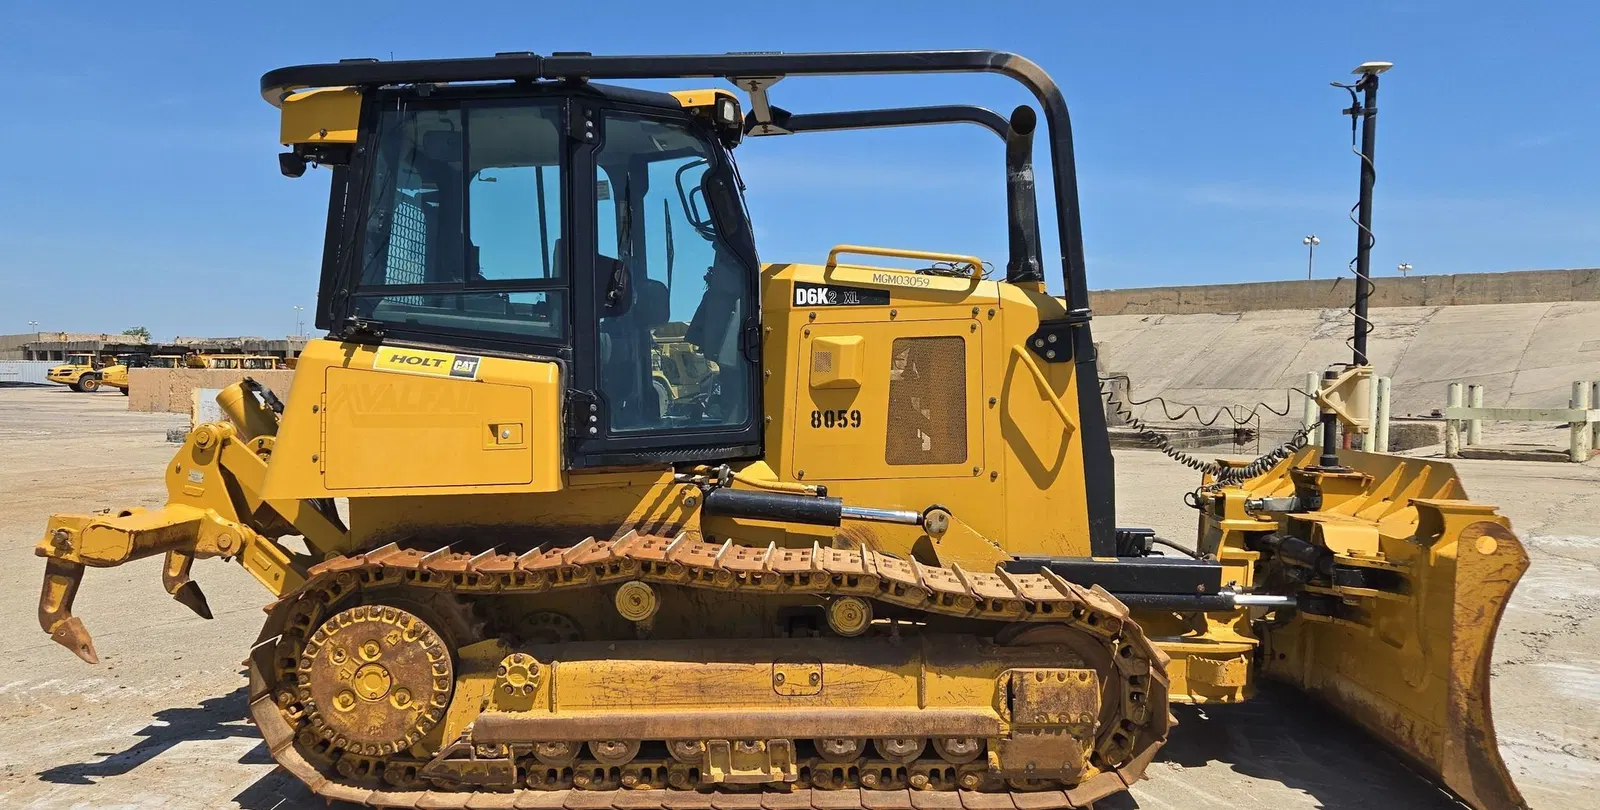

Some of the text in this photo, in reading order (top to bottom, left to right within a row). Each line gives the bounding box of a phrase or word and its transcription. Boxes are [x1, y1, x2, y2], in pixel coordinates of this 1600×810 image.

[843, 291, 860, 304] XL
[389, 354, 476, 373] HOLT CAT
[810, 409, 862, 428] 8059
